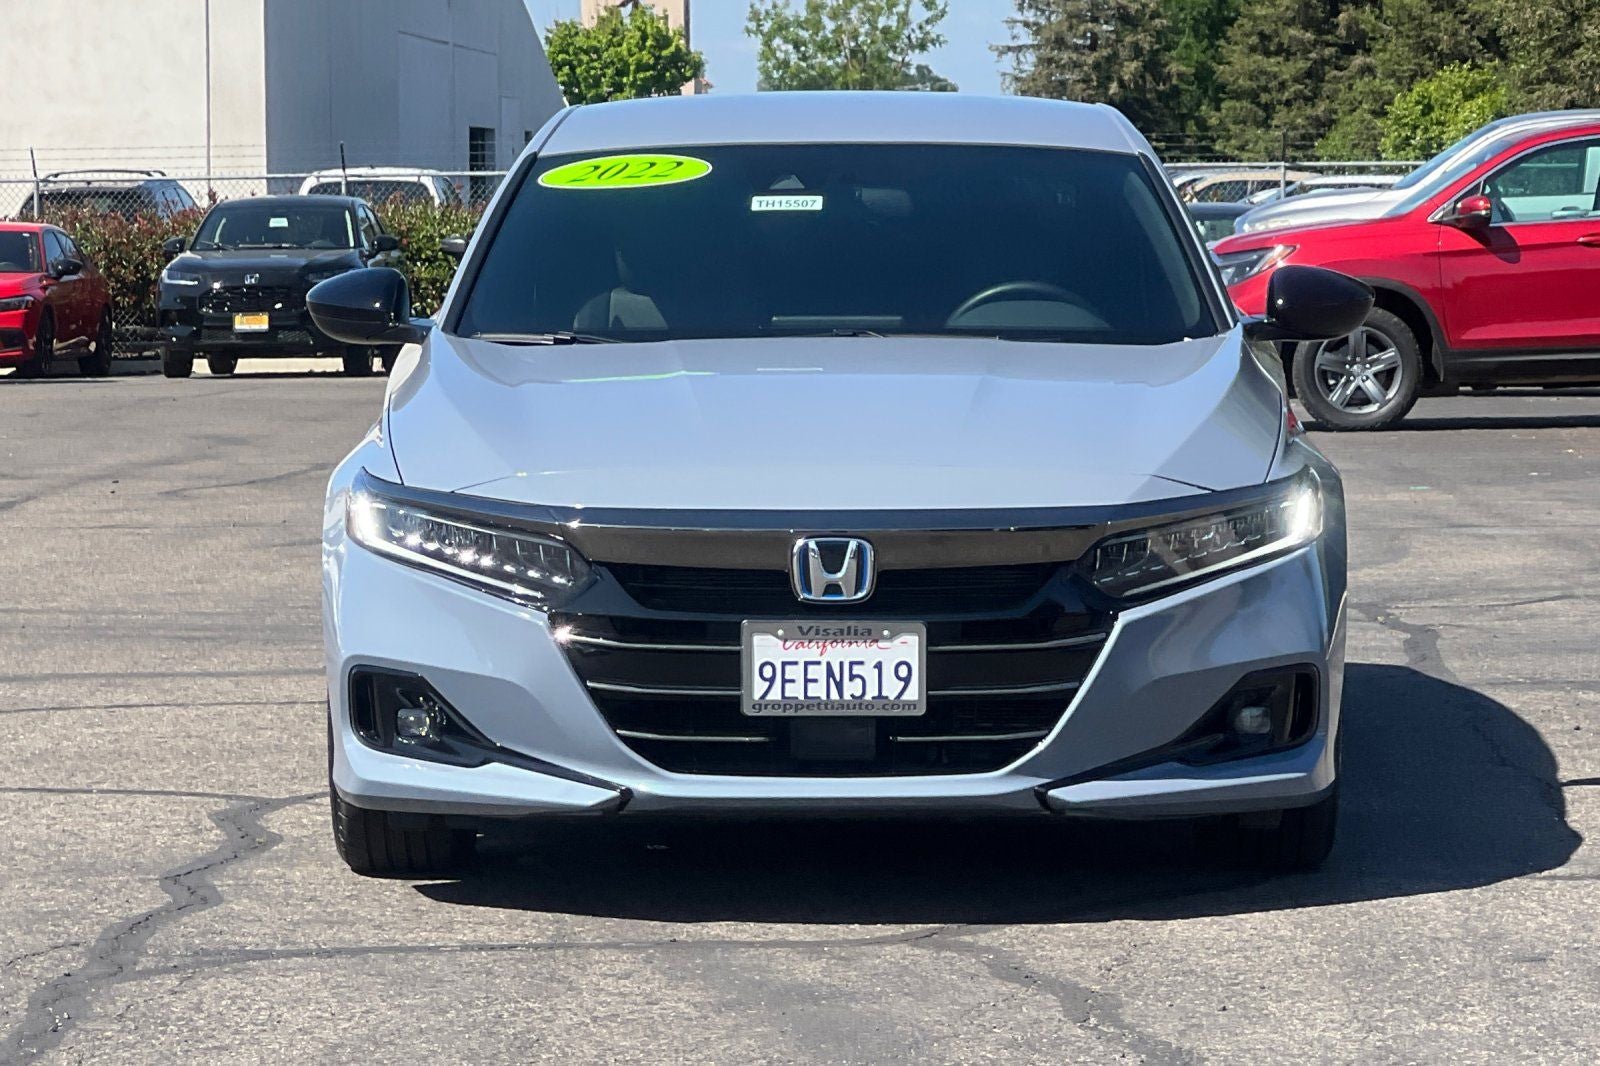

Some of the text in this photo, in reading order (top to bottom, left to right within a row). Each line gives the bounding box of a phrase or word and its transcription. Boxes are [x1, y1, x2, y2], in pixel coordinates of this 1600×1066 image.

[565, 160, 684, 184] 2022
[756, 199, 817, 208] TH15507
[797, 625, 873, 637] Visalia
[758, 660, 913, 700] 9EEN519
[751, 701, 917, 713] groppettiauto.com
